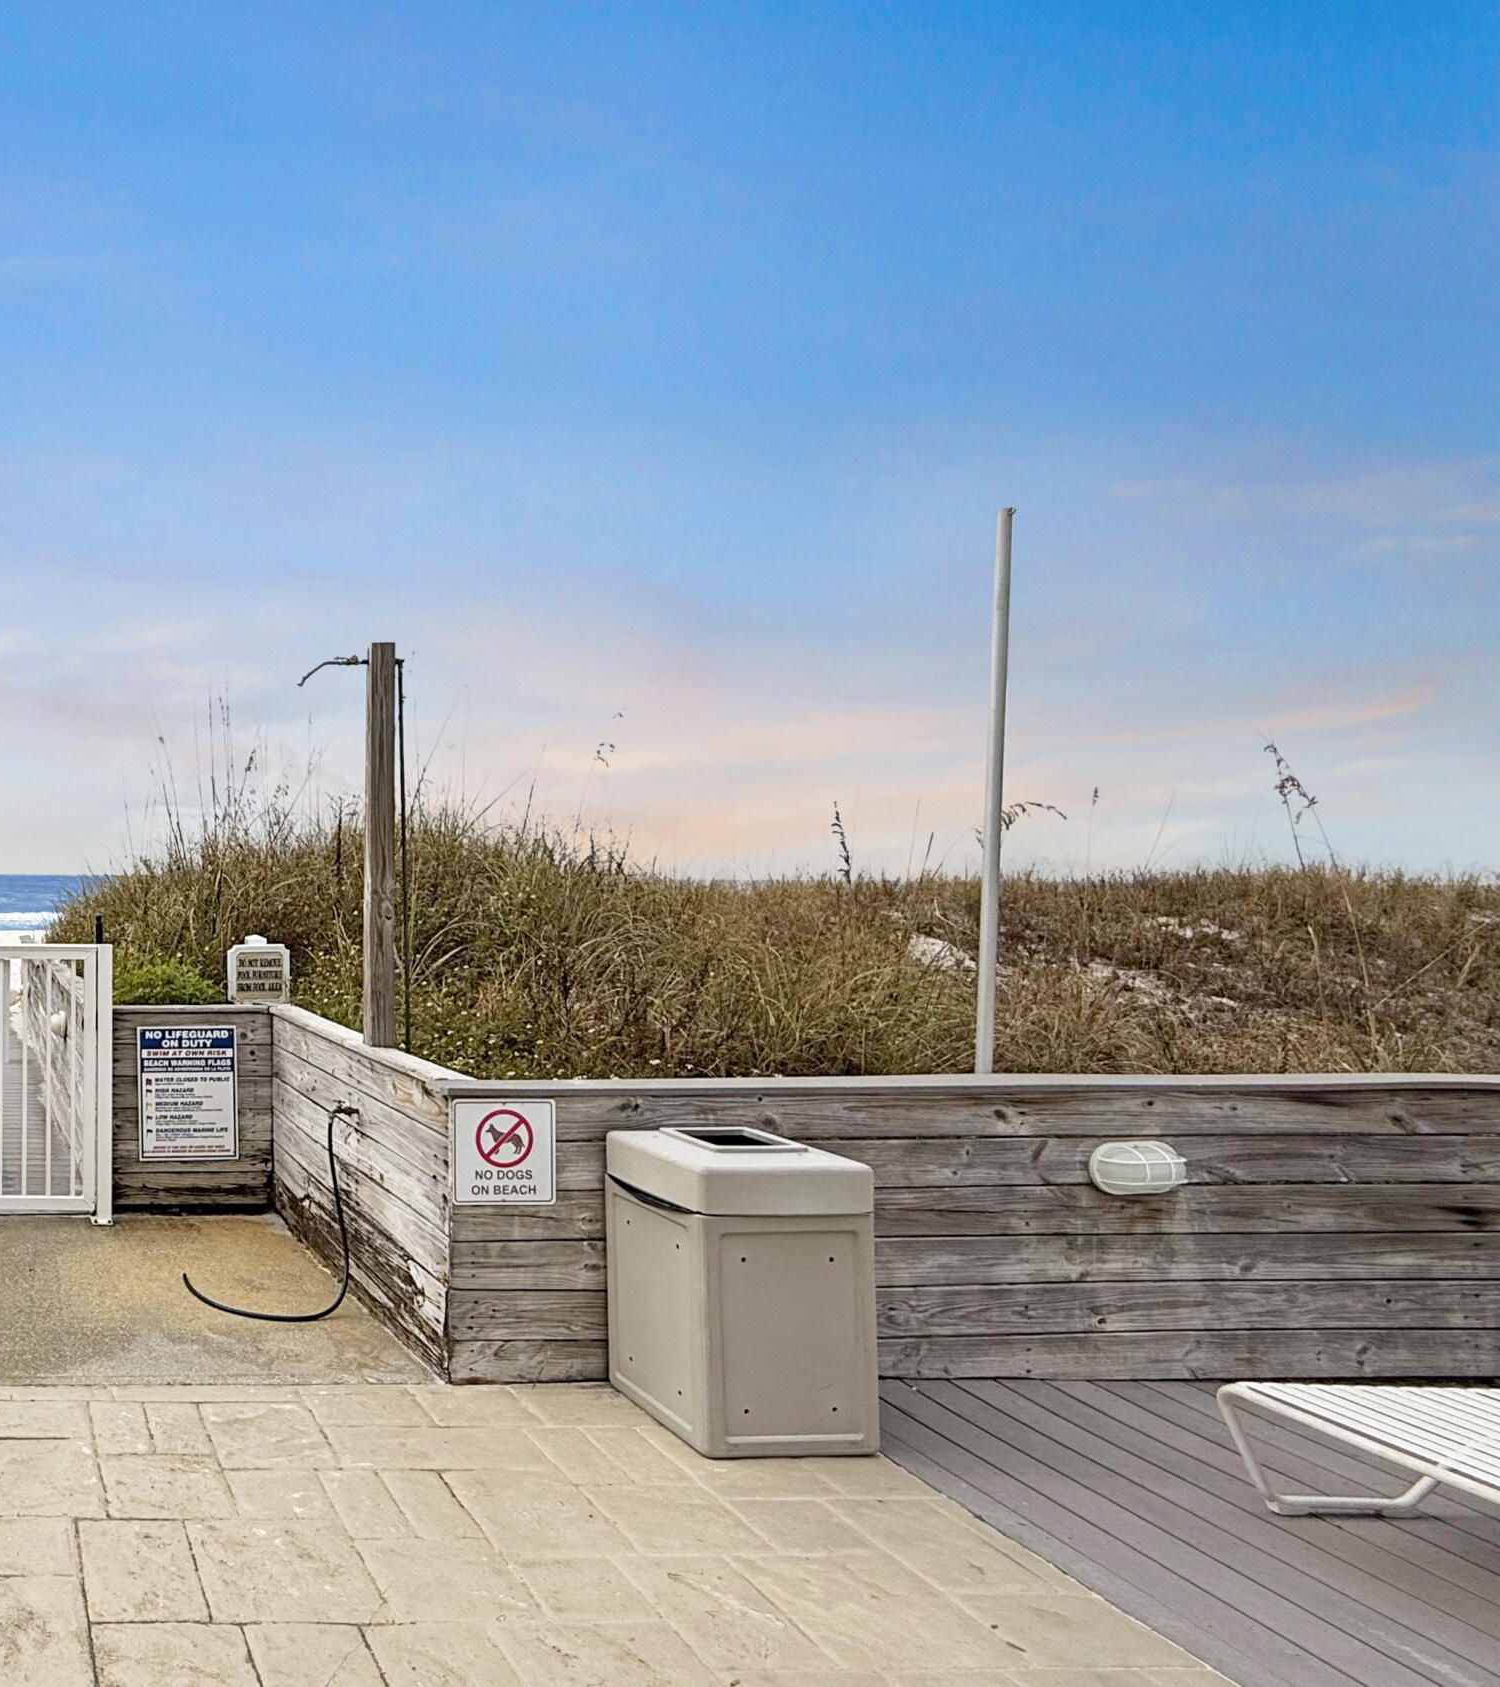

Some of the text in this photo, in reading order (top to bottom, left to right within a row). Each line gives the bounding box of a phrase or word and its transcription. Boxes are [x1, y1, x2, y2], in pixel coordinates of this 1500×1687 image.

[145, 1030, 229, 1039] NO LIFEGUARD
[161, 1039, 212, 1048] ON DUTY
[143, 1059, 169, 1067] BEACH
[170, 1059, 205, 1067] WARNING
[475, 1170, 533, 1180] NO DOGS
[471, 1185, 537, 1195] ON BEACH
